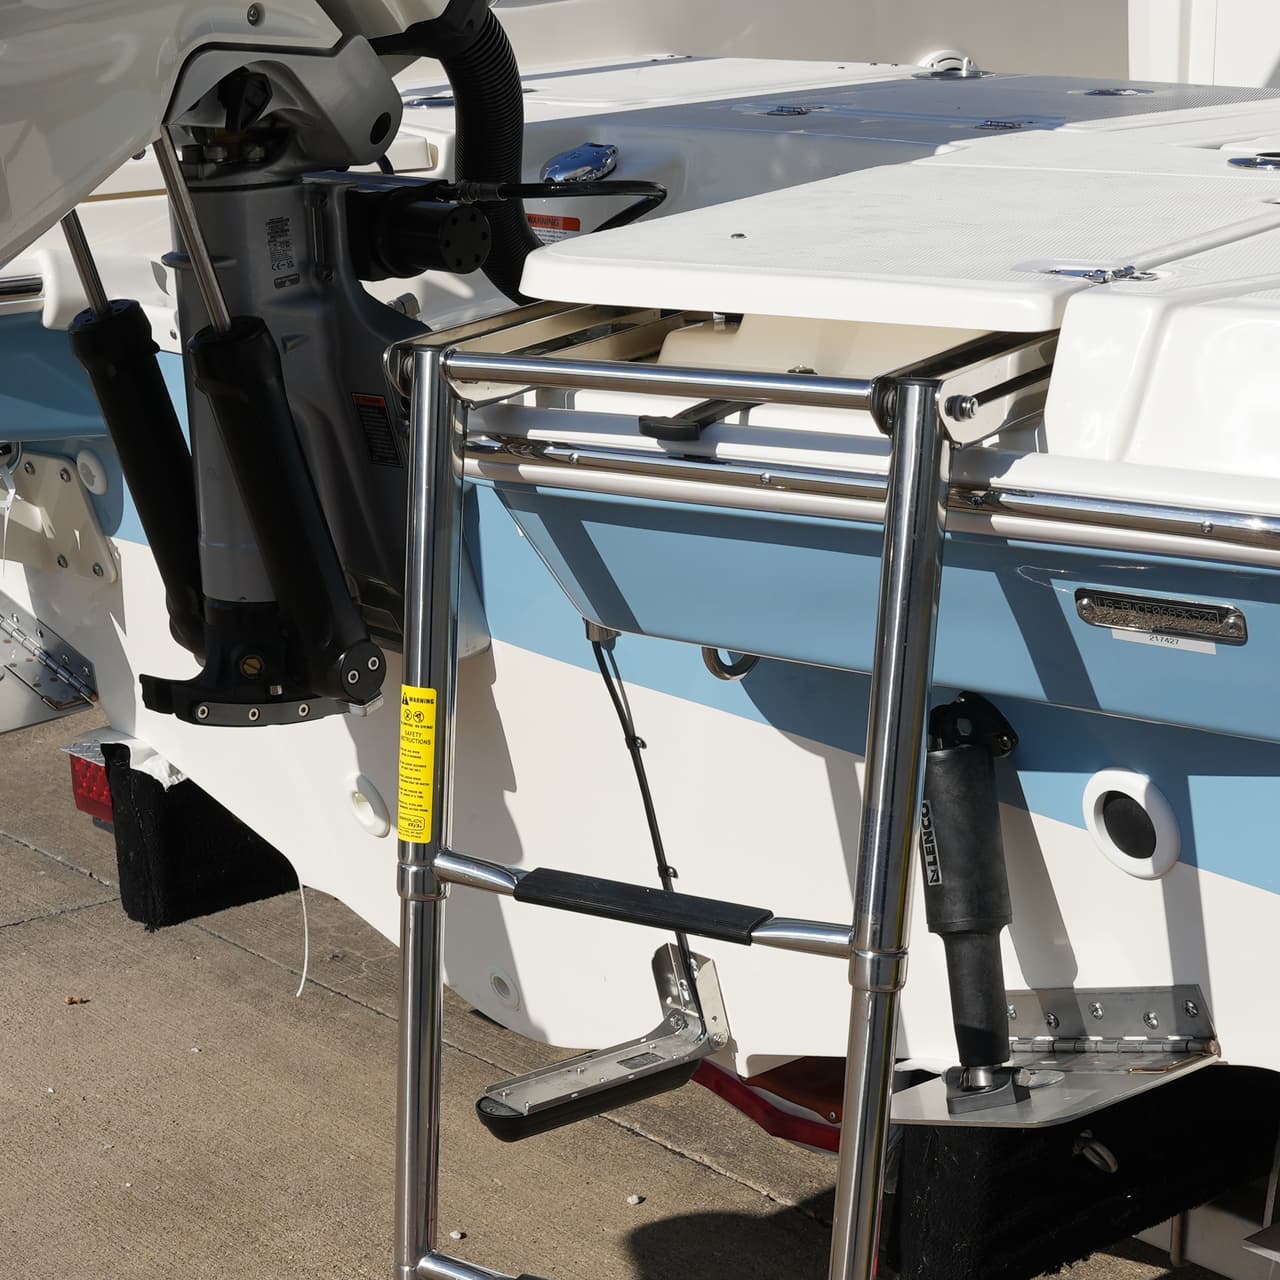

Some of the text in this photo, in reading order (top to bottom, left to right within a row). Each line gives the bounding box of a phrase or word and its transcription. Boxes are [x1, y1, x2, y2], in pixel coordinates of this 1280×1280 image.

[409, 696, 435, 705] WARNING
[404, 730, 422, 738] SAFETY
[922, 802, 937, 867] LENCO
